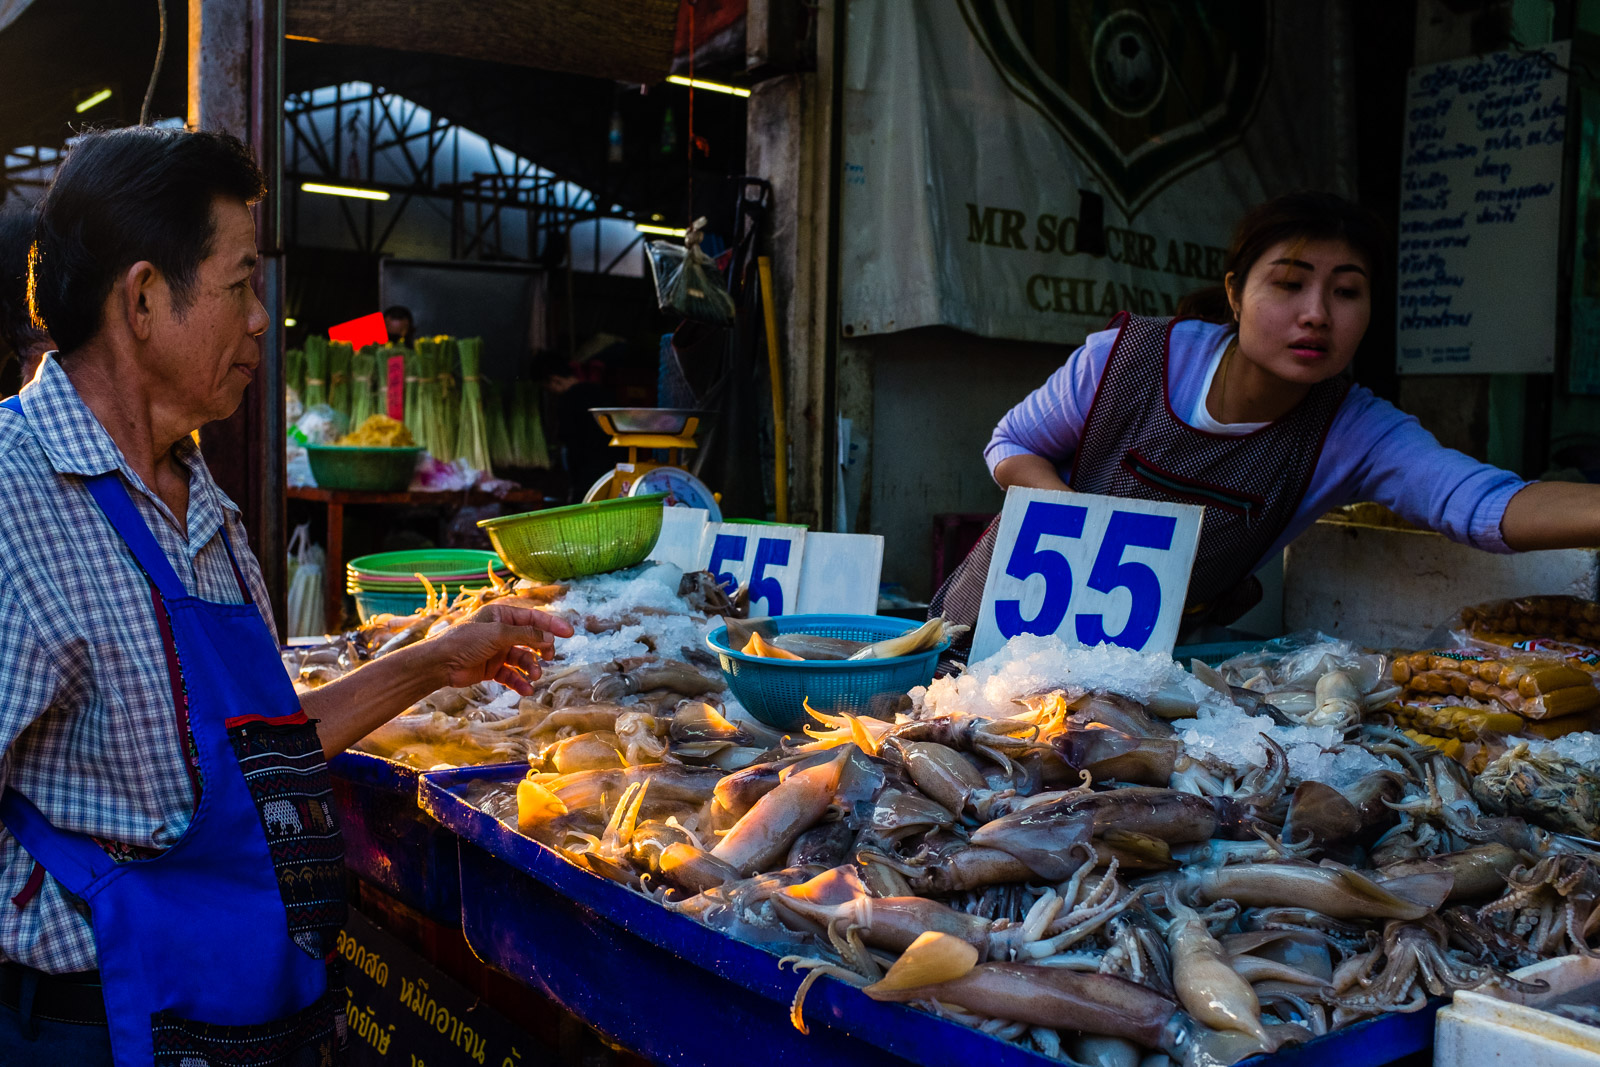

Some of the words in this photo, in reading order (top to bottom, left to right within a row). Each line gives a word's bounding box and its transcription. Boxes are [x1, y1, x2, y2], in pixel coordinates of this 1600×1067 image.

[966, 203, 1028, 250] MR
[1036, 213, 1159, 271] SOCER
[1026, 273, 1158, 317] CHIANG
[708, 533, 792, 616] 55
[995, 500, 1178, 652] 55
